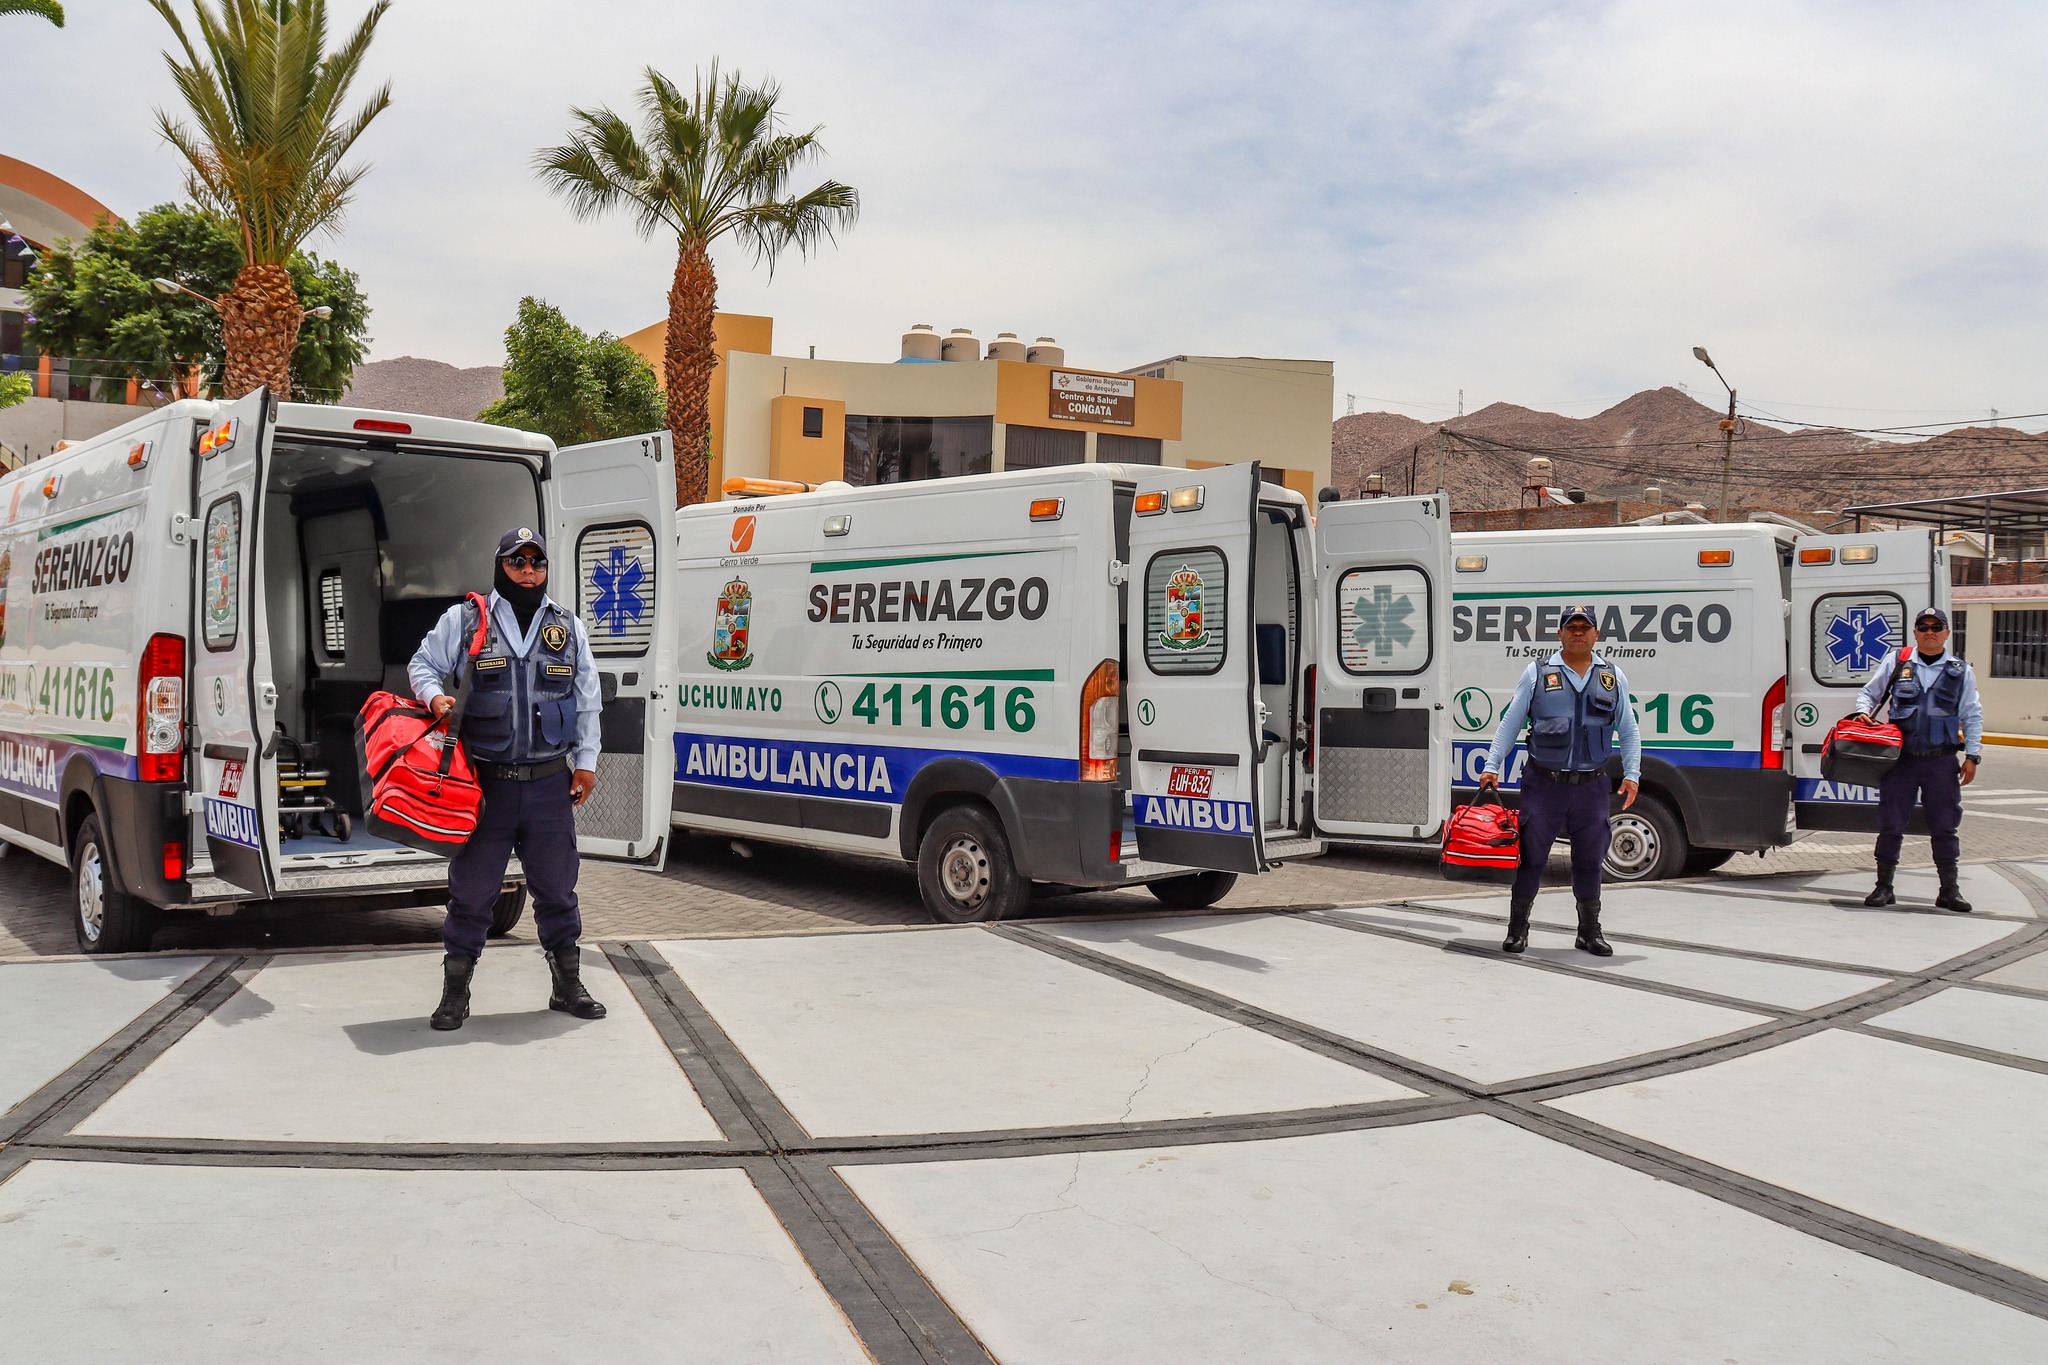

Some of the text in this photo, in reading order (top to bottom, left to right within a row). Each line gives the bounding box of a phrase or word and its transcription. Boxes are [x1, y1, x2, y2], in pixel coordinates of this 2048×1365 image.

[1060, 392, 1084, 401] Centro
[1096, 396, 1118, 404] Salud
[1076, 376, 1128, 387] Gobierno Regional
[1068, 402, 1112, 416] CONGATA
[733, 505, 754, 513] Donado
[32, 531, 134, 594] SERENAZGO
[720, 556, 759, 567] Cerro Verde
[807, 576, 1049, 624] SERENAZGO
[852, 632, 982, 652] Tu Seguridad es Primero
[1453, 604, 1732, 644] SEREAZGO
[1506, 646, 1520, 657] Tu
[1604, 646, 1656, 658] Primero
[40, 666, 114, 722] 411616
[678, 683, 1036, 733] UCHUMAYO 411616
[686, 743, 893, 794] AMBULANCIA
[208, 800, 258, 846] AMBUL
[1144, 797, 1254, 833] AMBUL
